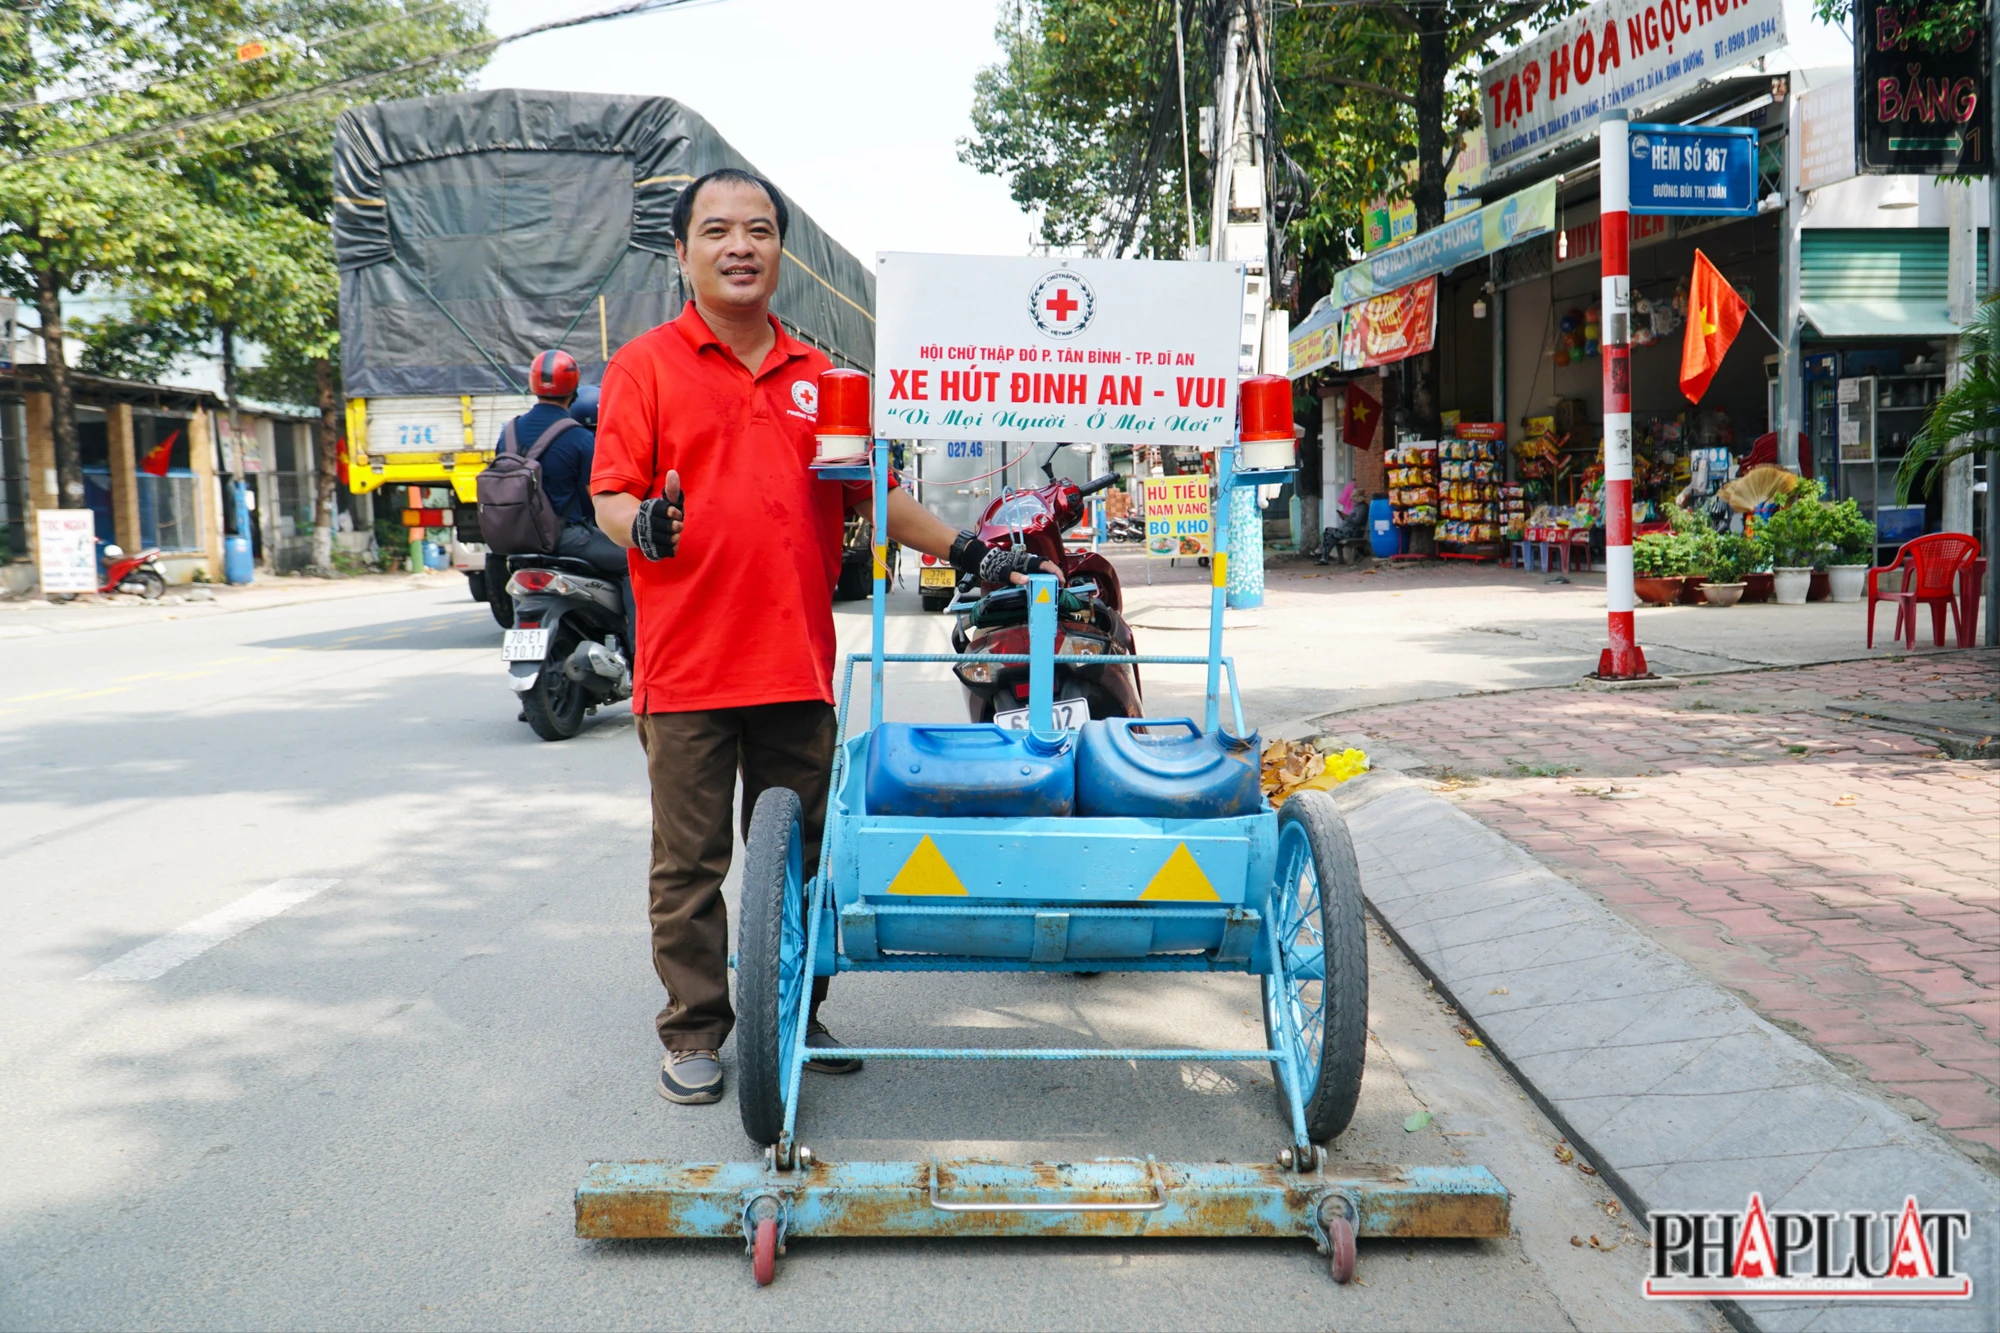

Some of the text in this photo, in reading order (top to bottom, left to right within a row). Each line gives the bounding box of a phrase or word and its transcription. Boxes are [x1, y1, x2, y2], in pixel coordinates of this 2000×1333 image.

[1728, 31, 1746, 53] 0908
[1747, 25, 1760, 45] 100
[1761, 16, 1776, 39] 944
[1488, 60, 1541, 130] TẠP
[1549, 18, 1621, 101] HÓA
[1627, 0, 1692, 60] NGỌC
[1877, 62, 1977, 124] BĂNG
[1652, 137, 1728, 172] HẺM SỐ 367
[1653, 184, 1727, 201] ĐƯỜNG BÙI THỊ XUÂN
[920, 344, 945, 362] HỘI
[948, 345, 977, 361] CHỮ
[980, 346, 1015, 362] THẬP
[1019, 344, 1037, 362] ĐỎ
[1042, 349, 1053, 363] P.
[1058, 348, 1083, 363] TÂN
[1088, 347, 1122, 364] BÌNH
[1135, 351, 1154, 366] TP.
[1157, 349, 1172, 365] DĨ
[1175, 352, 1195, 366] AN
[889, 368, 929, 401] XE
[940, 364, 1000, 402] HÚT
[1010, 372, 1088, 404] ĐINH
[1097, 375, 1142, 406] AN
[1176, 376, 1227, 408] VUI
[937, 408, 983, 429] Mọi
[991, 409, 1066, 432] Người
[1086, 408, 1106, 430] Ở
[1110, 412, 1156, 434] Mọi
[947, 441, 983, 458] 027.46
[1147, 479, 1207, 501] HỦ TIẾU
[1148, 502, 1207, 516] NAM VANG
[1149, 517, 1209, 535] BÒ KHO
[930, 569, 946, 578] 37H
[510, 631, 541, 644] 70-E1
[504, 645, 544, 659] 510.17
